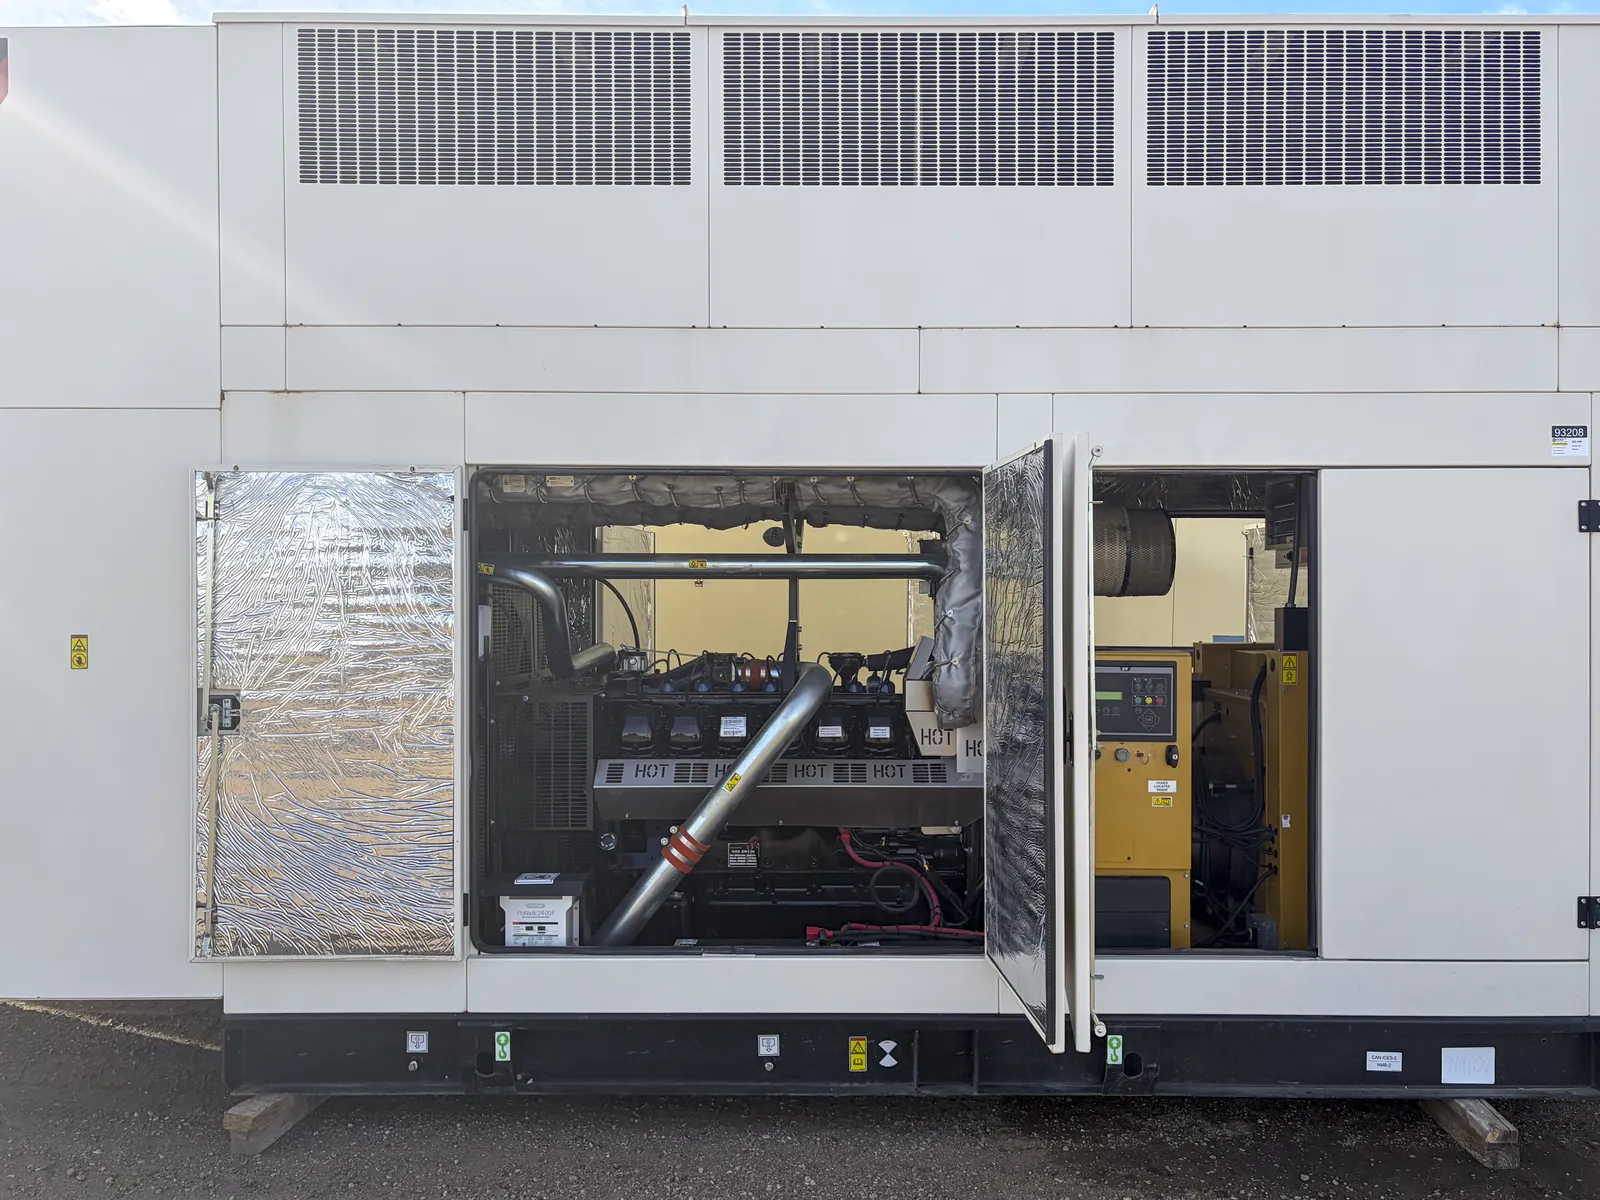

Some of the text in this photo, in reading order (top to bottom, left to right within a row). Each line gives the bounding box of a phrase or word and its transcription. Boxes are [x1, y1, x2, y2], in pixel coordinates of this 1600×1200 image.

[1554, 428, 1584, 437] 93208
[921, 728, 954, 746] HOT
[635, 764, 670, 778] HOT
[794, 764, 828, 778] HOT
[873, 764, 907, 778] HOT
